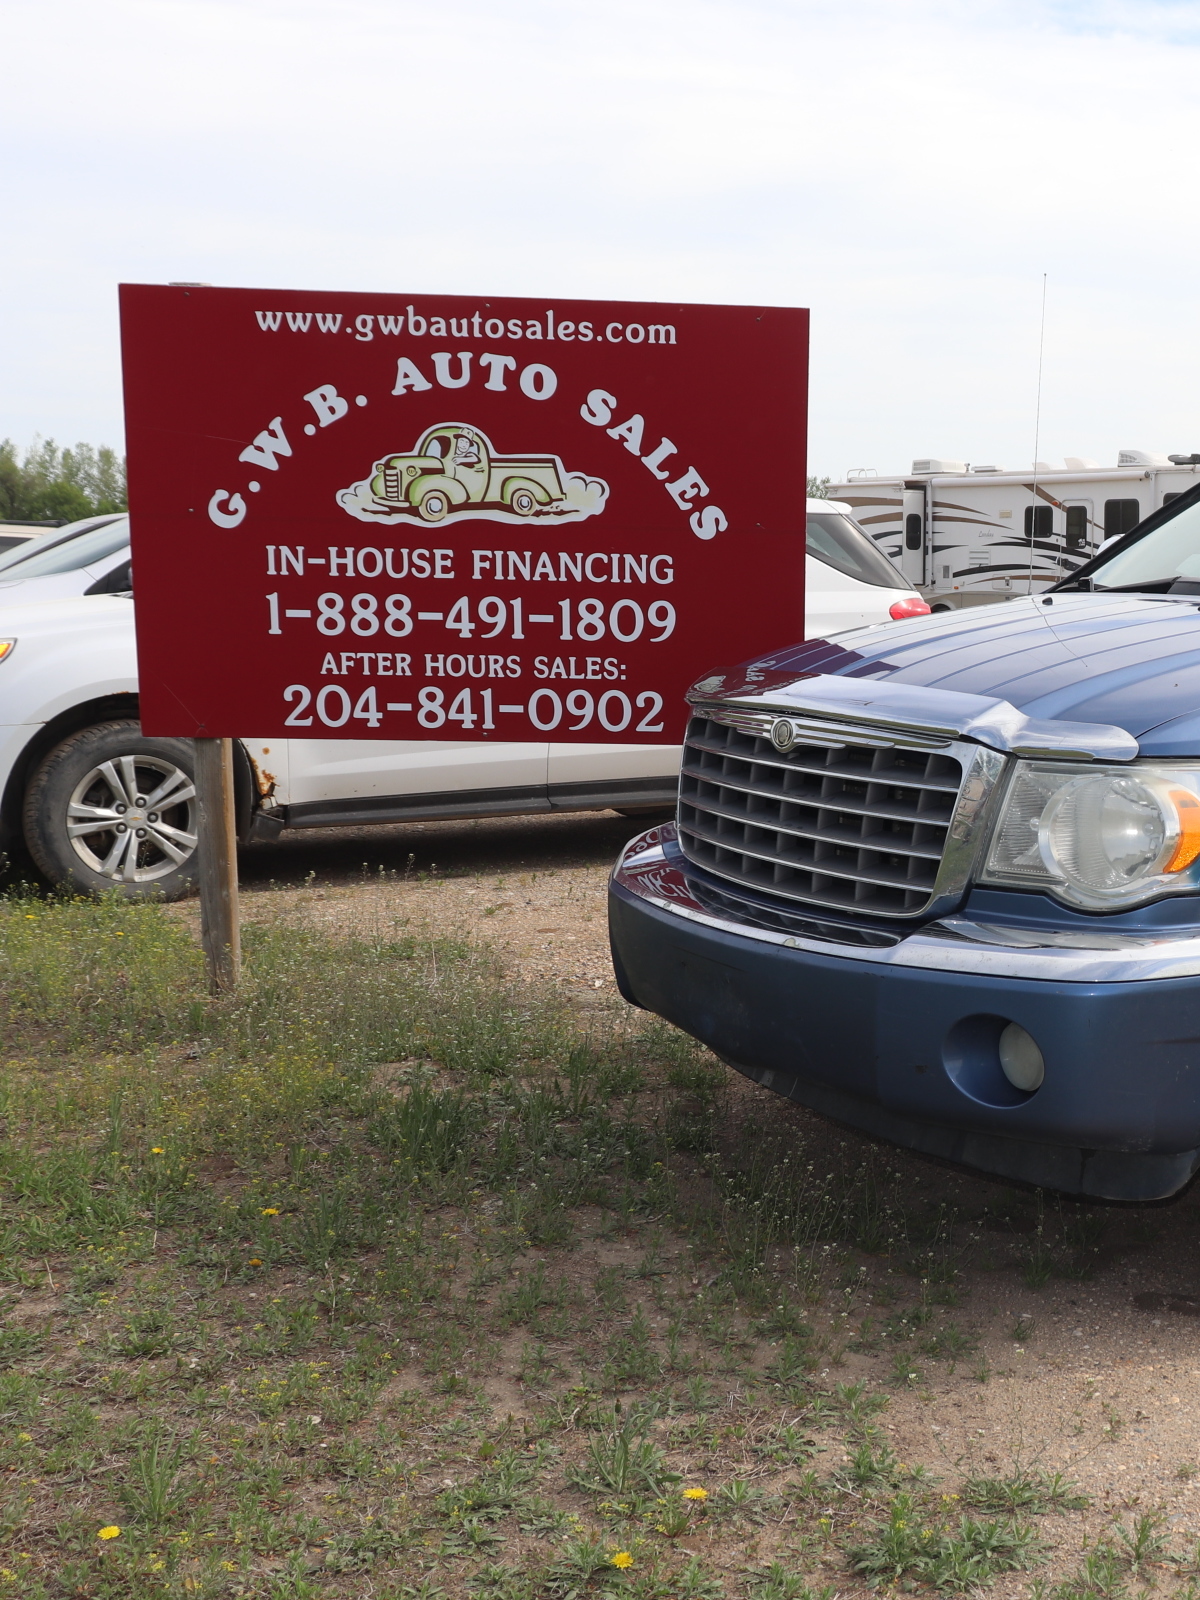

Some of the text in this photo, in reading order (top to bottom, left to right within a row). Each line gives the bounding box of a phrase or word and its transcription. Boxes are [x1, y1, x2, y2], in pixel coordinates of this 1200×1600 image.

[255, 306, 677, 345] www.gwbautosales.com
[208, 352, 728, 541] G.W.B. AUTO SALES
[265, 545, 674, 585] IN-HOUSE FINANCING
[265, 591, 677, 643] 1-888-491-1809
[320, 651, 628, 680] AFTER HOURS SALES:
[283, 684, 665, 733] 204-841-0902
